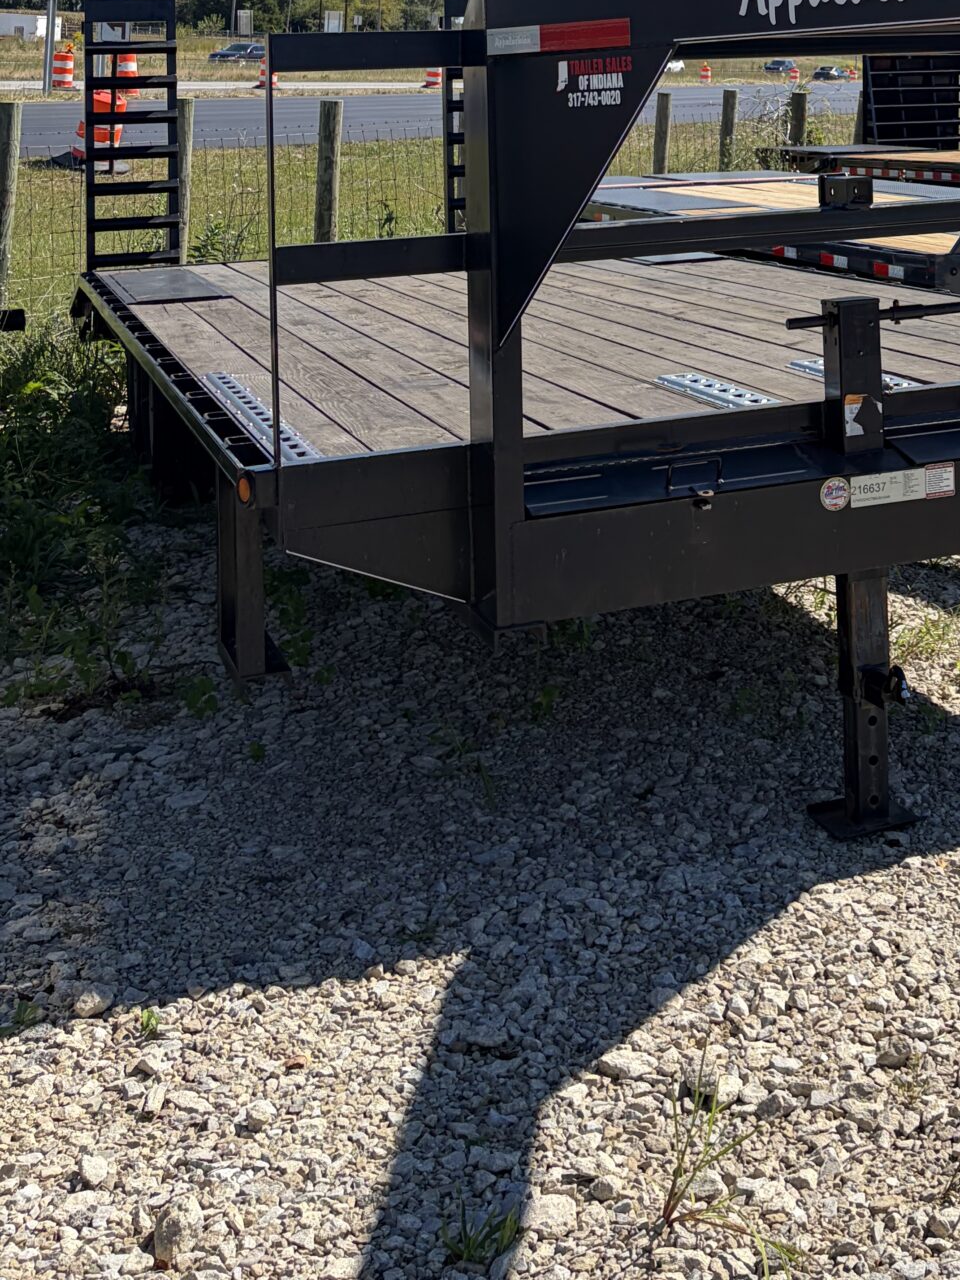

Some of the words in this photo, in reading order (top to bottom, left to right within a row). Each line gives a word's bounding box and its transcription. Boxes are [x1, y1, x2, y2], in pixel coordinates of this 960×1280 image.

[569, 58, 603, 75] TRAILER
[606, 56, 633, 73] SALES
[578, 75, 590, 91] OF
[589, 72, 624, 90] INDIANA
[567, 90, 621, 108] 317-743-0020
[850, 482, 887, 496] 216637
